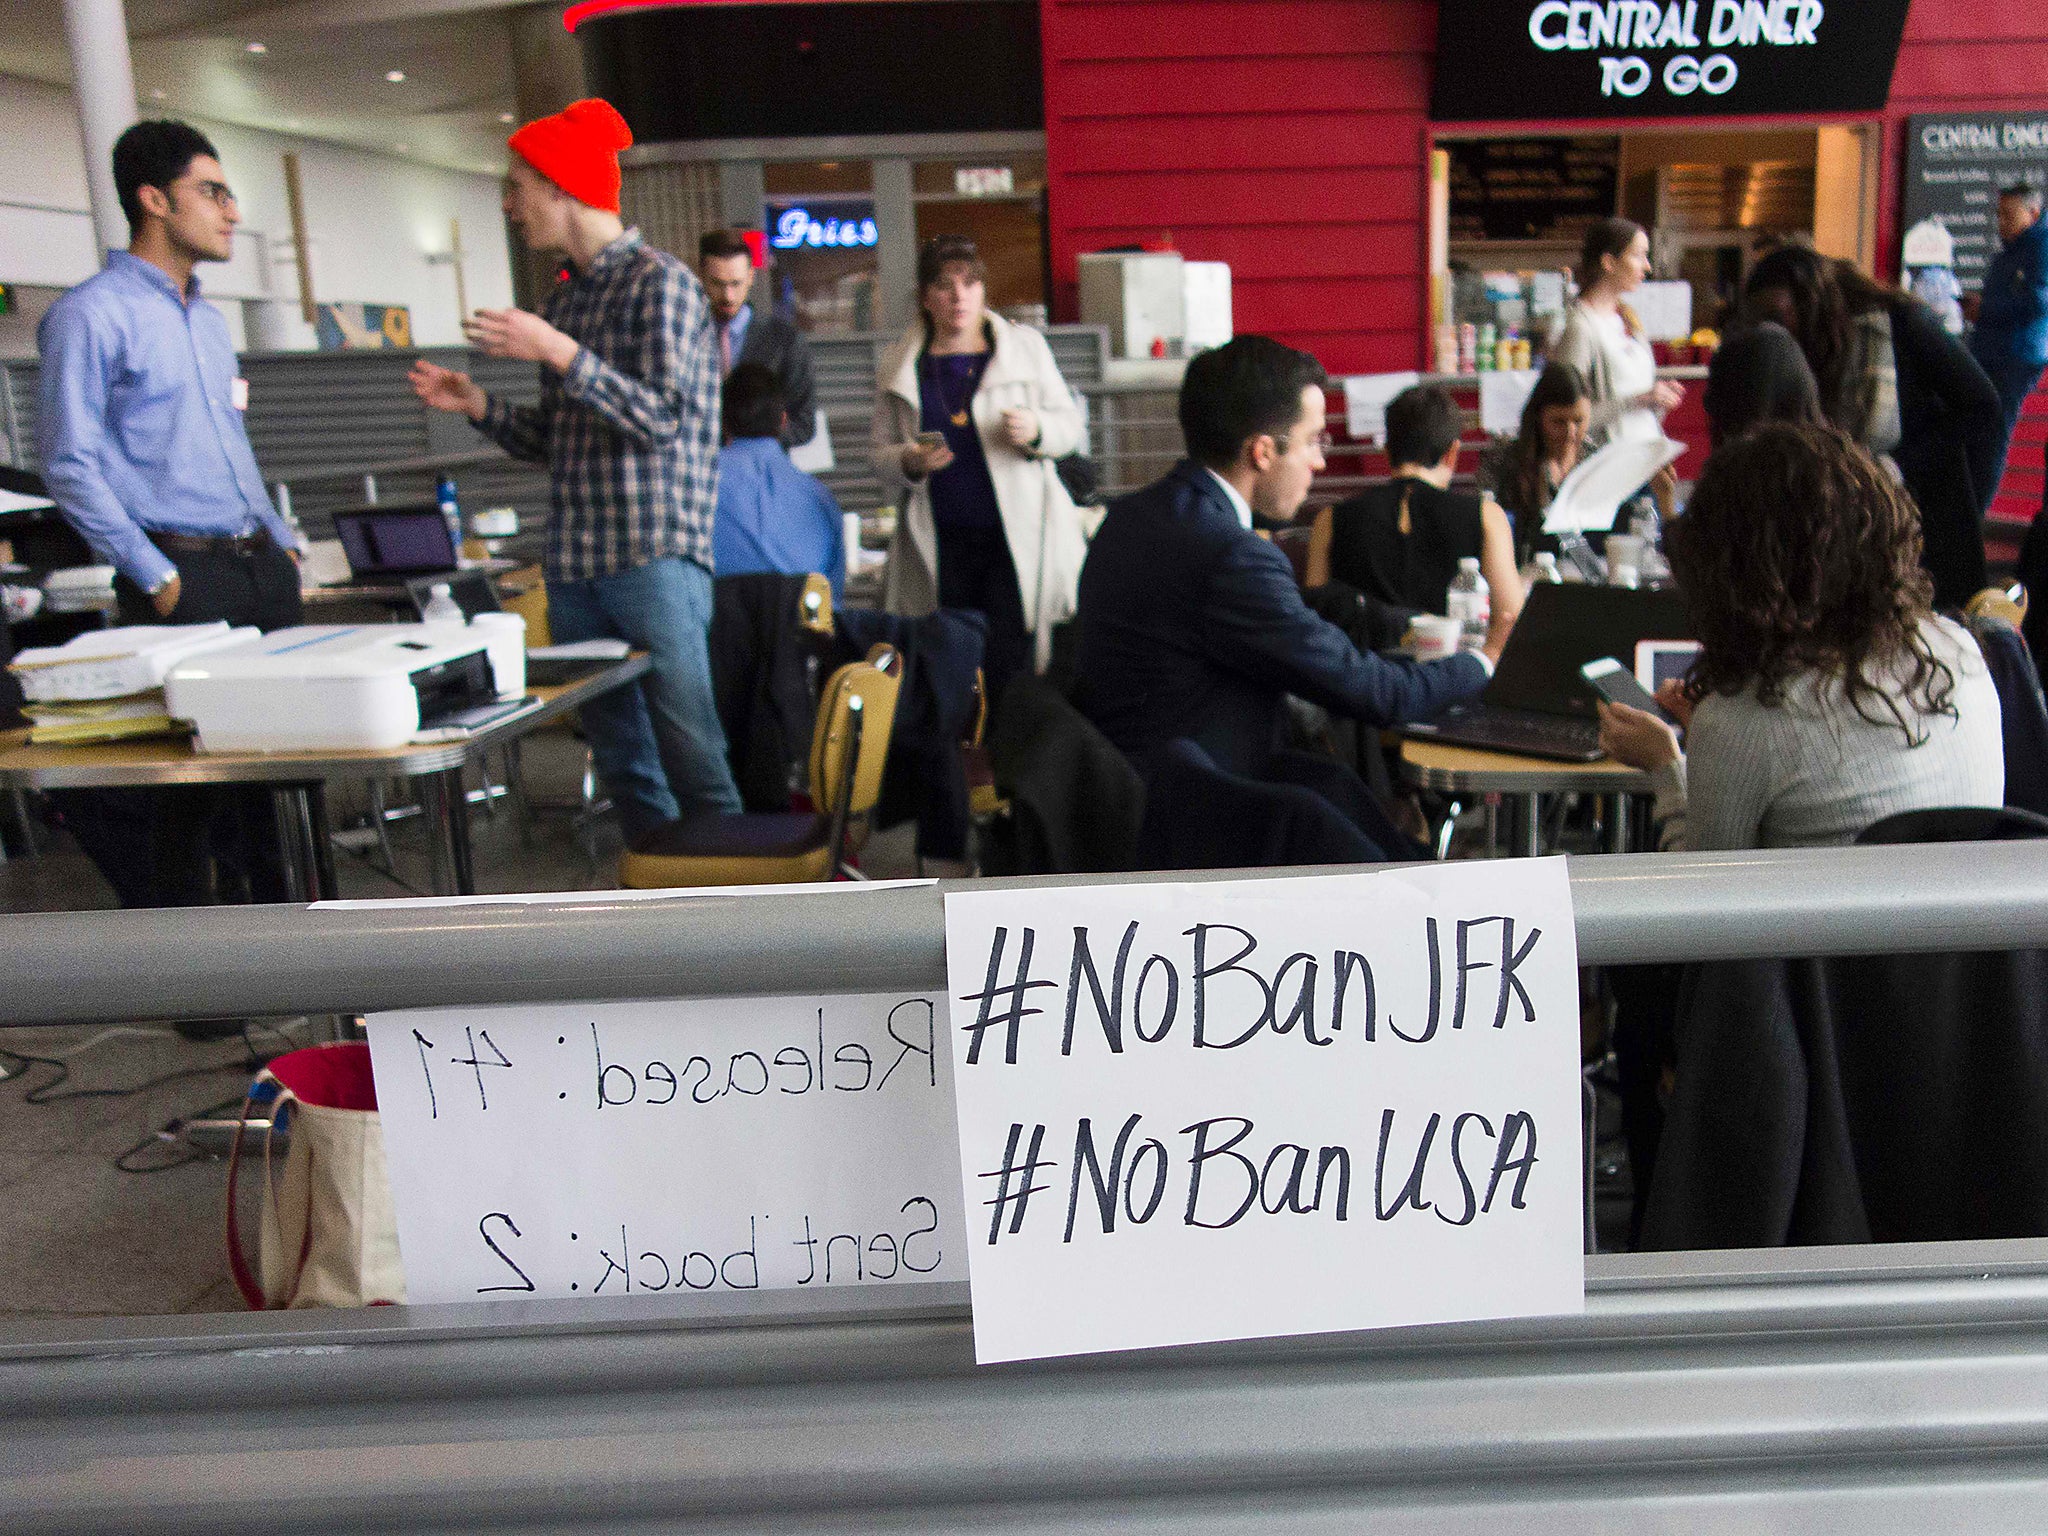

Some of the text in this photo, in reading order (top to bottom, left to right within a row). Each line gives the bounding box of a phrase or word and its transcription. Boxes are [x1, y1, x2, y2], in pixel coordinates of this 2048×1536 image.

[1528, 0, 1825, 51] CENTRAL DINER
[1598, 54, 1739, 97] TO GO
[1921, 124, 1998, 150] CENTRAL
